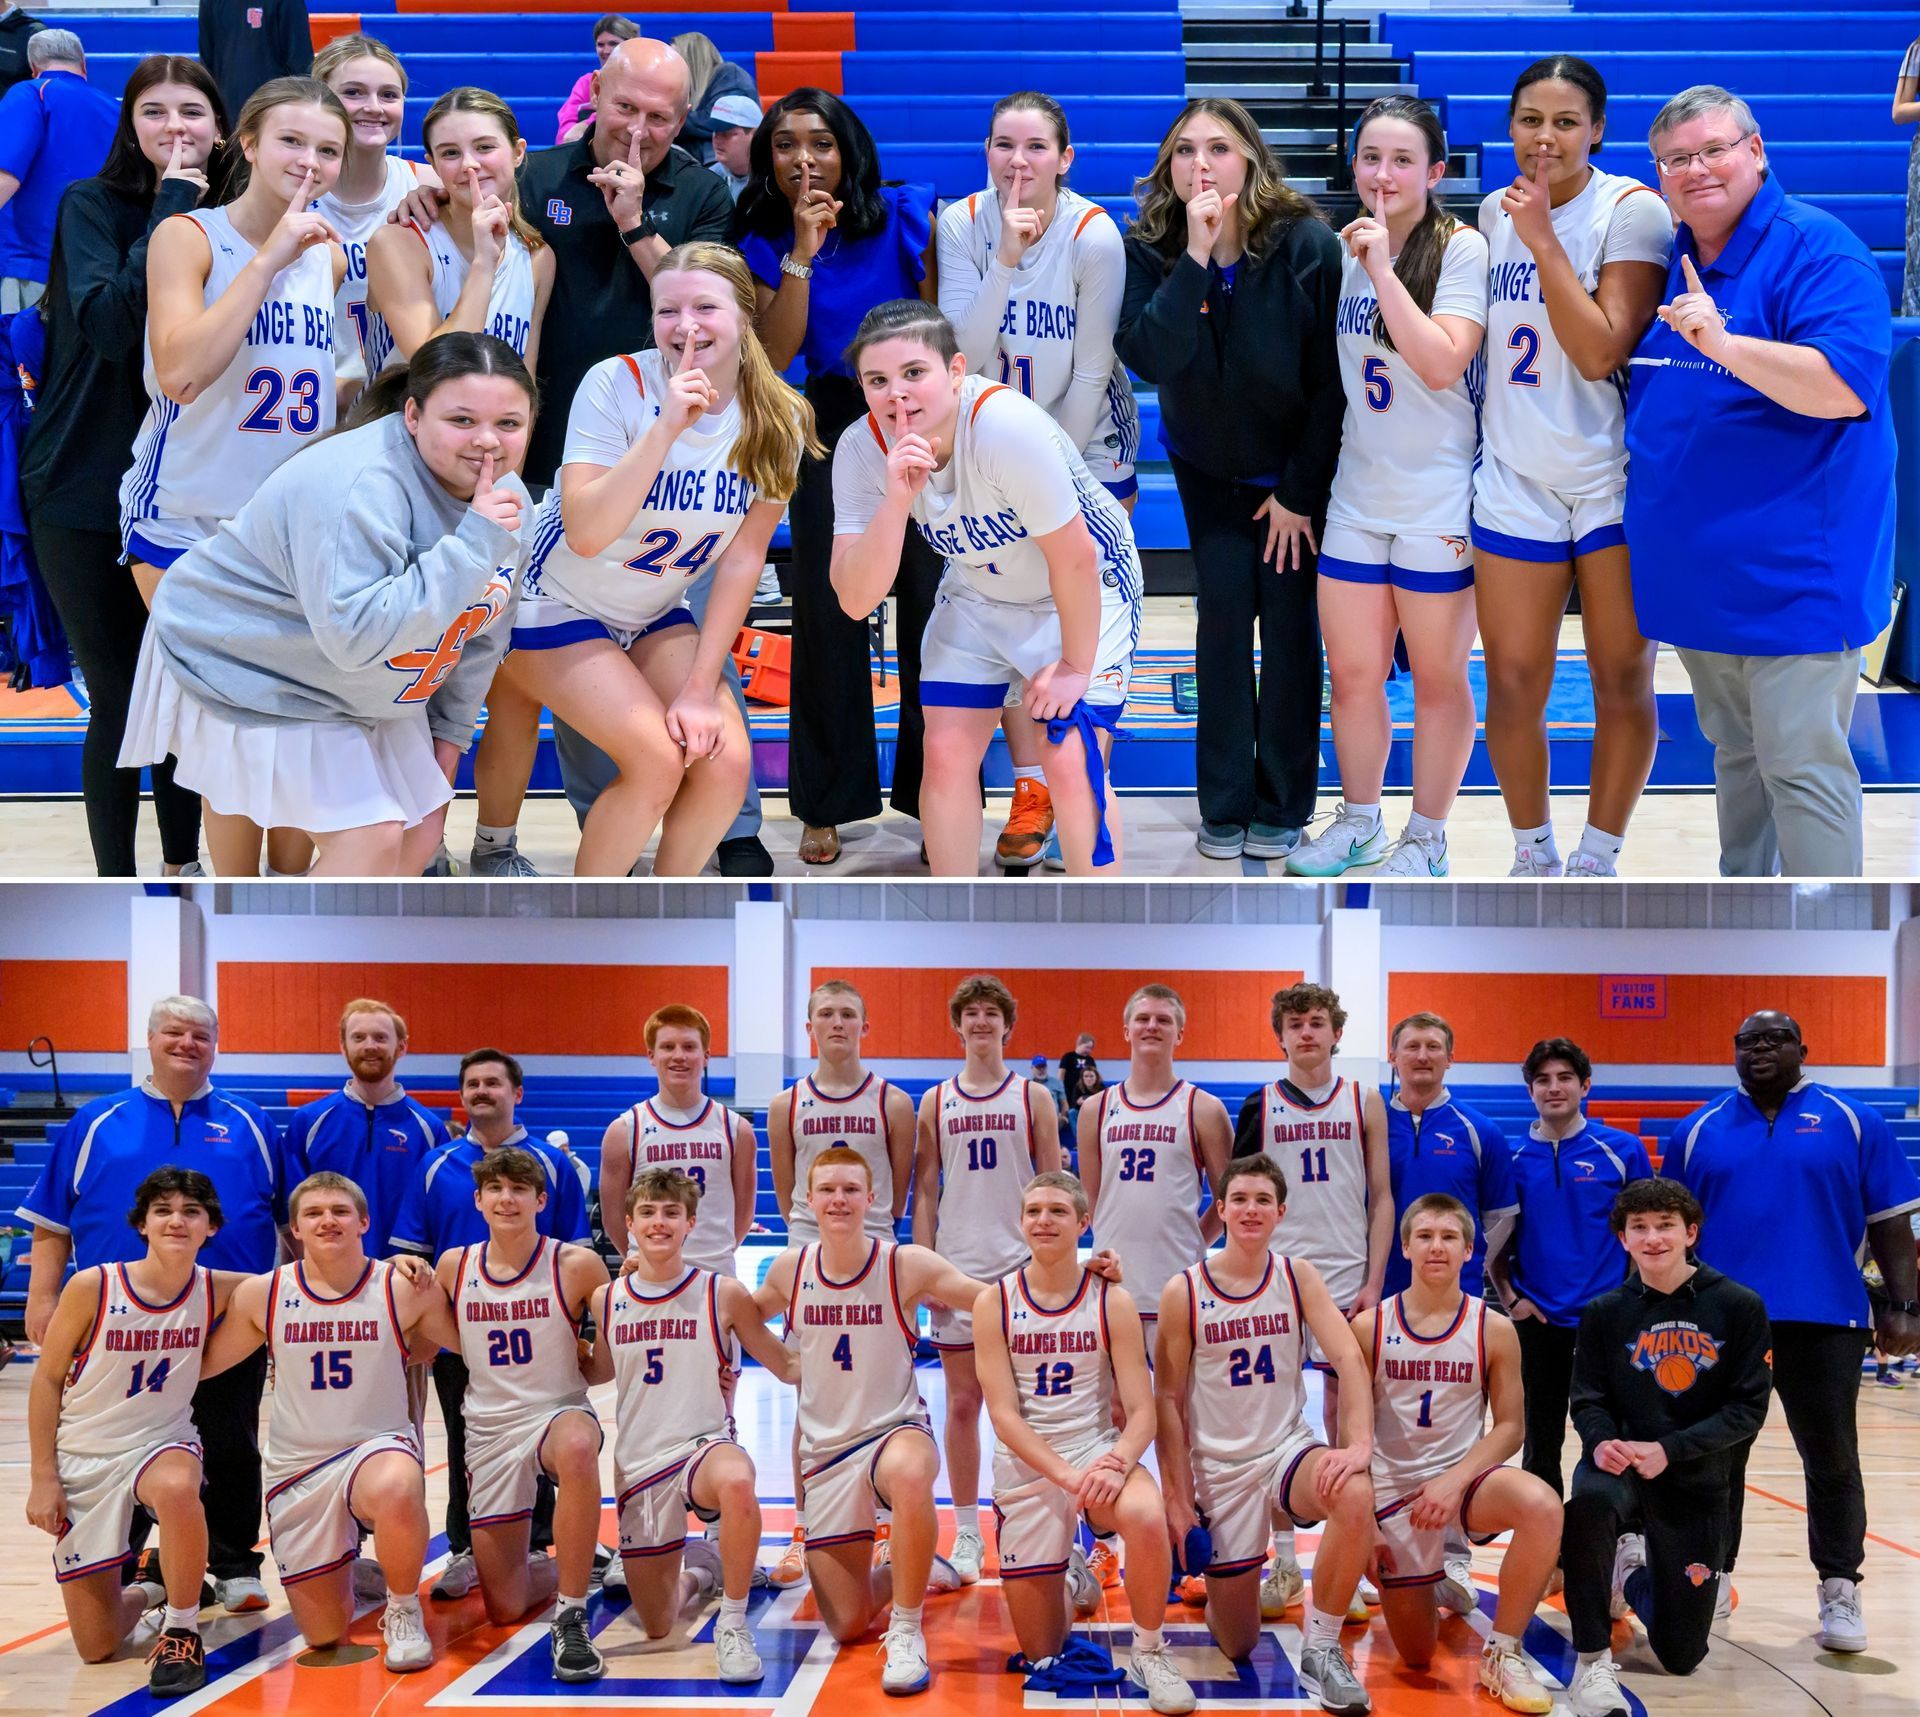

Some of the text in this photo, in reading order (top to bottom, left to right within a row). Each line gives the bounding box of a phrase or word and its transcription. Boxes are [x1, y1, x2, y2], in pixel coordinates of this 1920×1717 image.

[1490, 262, 1537, 305] ANGE
[245, 300, 335, 354] ANGE BEA
[1337, 296, 1378, 336] ANGE
[493, 312, 530, 359] BEAC
[1507, 323, 1541, 387] 2
[238, 366, 320, 435] 23
[1362, 355, 1394, 413] 5
[641, 469, 758, 516] ANGE BEAC
[960, 507, 1028, 551] BEAC
[623, 527, 725, 578] 24
[1611, 982, 1656, 994] VISITOR
[1611, 995, 1656, 1010] FANS
[802, 1115, 876, 1136] ORANGE BEACH
[947, 1113, 1016, 1136] ORANGE BEACH
[1106, 1123, 1177, 1144] ORANGE BEACH
[1273, 1120, 1352, 1144] ORANGE BEACH
[646, 1142, 723, 1163] ORANGE BEACH
[967, 1137, 998, 1171] 10
[1119, 1147, 1156, 1183] 32
[1300, 1147, 1330, 1183] 11
[668, 1165, 706, 1199] 3
[466, 1297, 550, 1322] ORANGE BEACH
[803, 1303, 883, 1326] ORANGE BEACH
[105, 1326, 201, 1352] ORANGE BEACH
[283, 1320, 379, 1344] ORANGE BEACH
[615, 1318, 698, 1346] ORANGE BEACH
[1011, 1330, 1098, 1355] ORANGE BEACH
[1204, 1312, 1290, 1345] ORANGE BEACH
[487, 1327, 534, 1367] 20
[832, 1333, 853, 1372] 4
[1229, 1343, 1276, 1387] 24
[1630, 1330, 1719, 1366] MAKOS
[126, 1356, 171, 1399] 14
[310, 1349, 353, 1391] 15
[642, 1347, 664, 1385] 5
[1033, 1361, 1075, 1397] 12
[1384, 1358, 1474, 1384] ORANGE BEACH
[1416, 1389, 1433, 1428] 1
